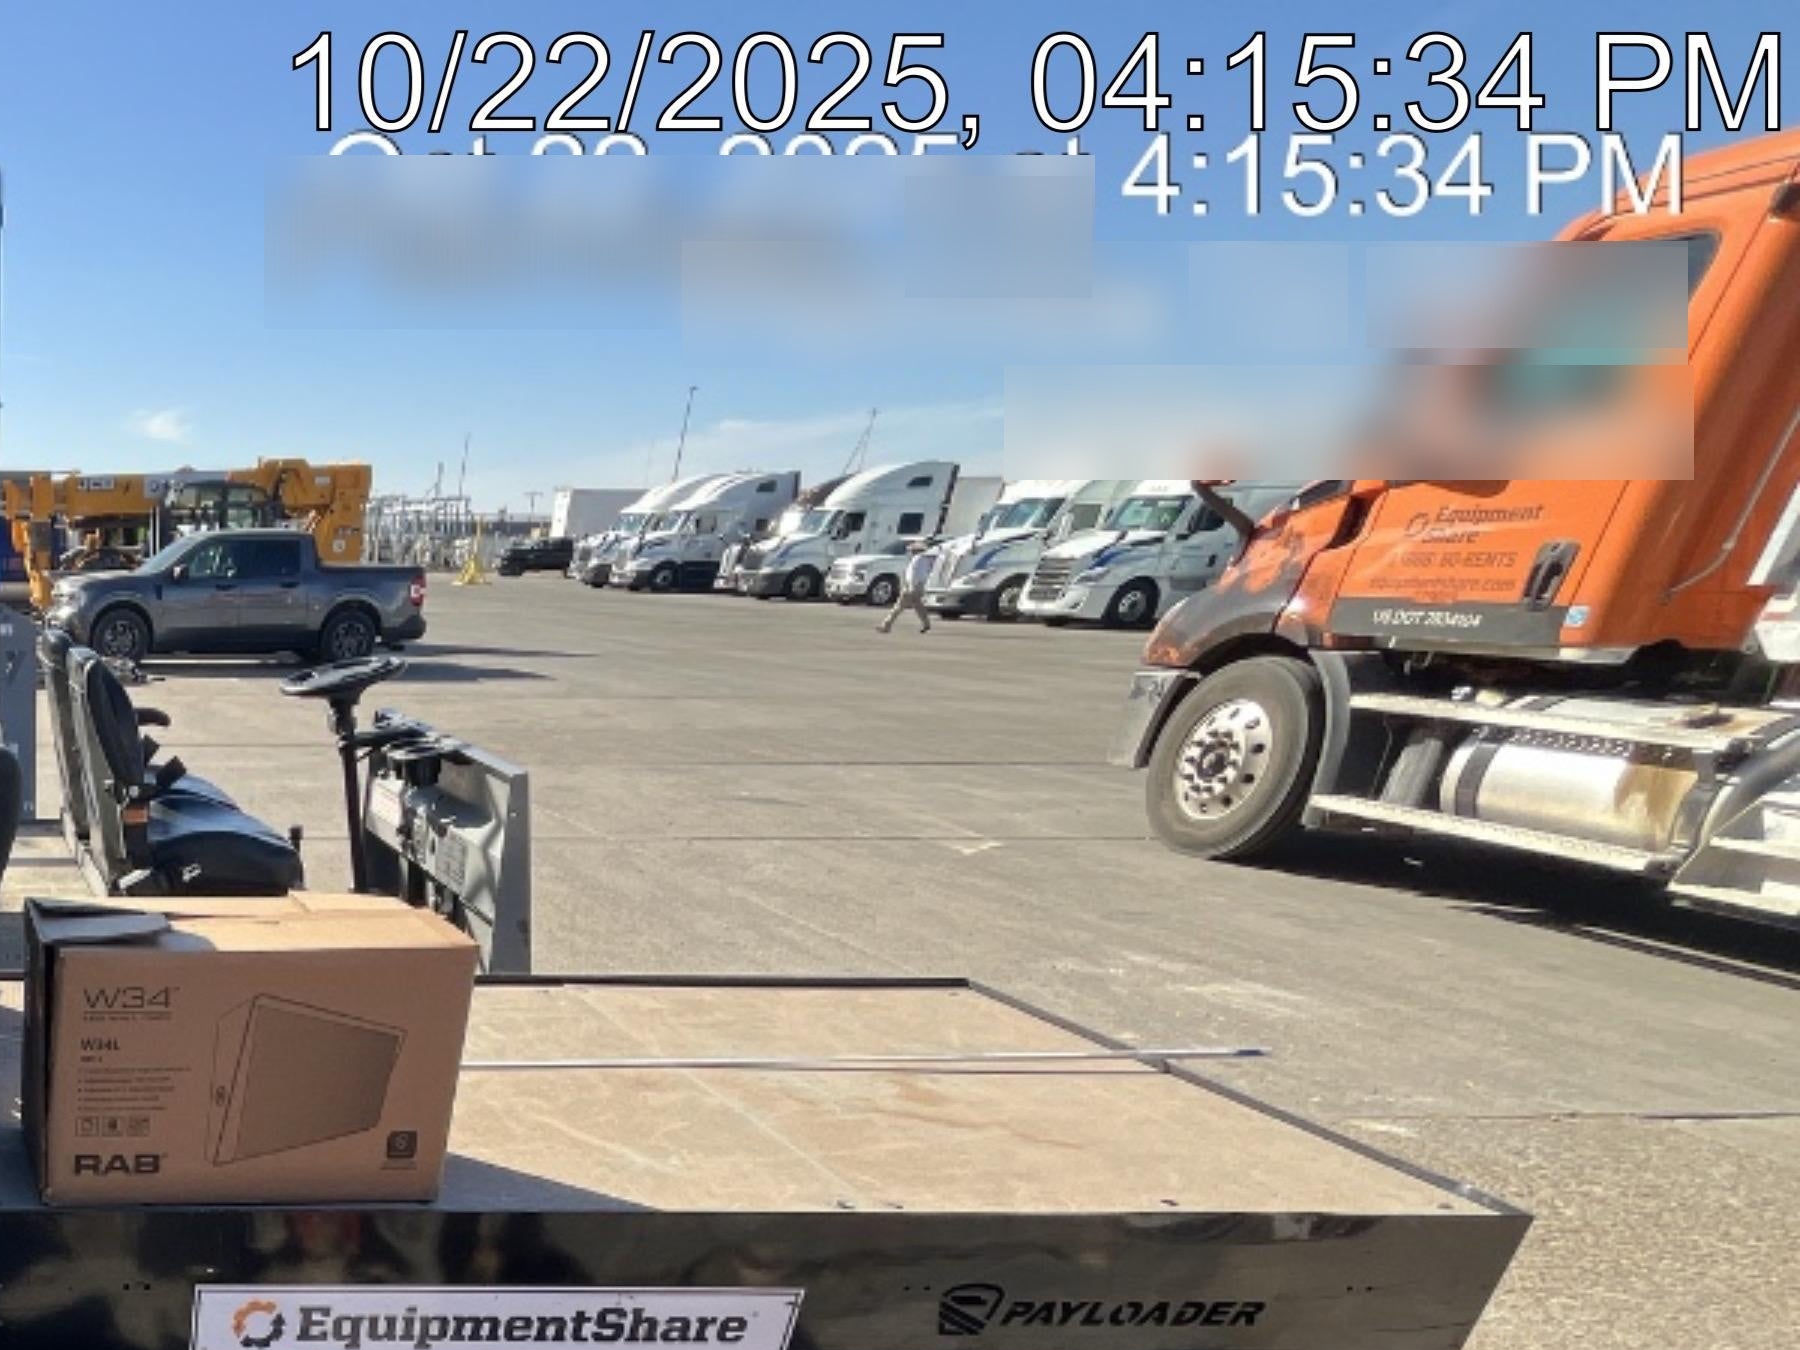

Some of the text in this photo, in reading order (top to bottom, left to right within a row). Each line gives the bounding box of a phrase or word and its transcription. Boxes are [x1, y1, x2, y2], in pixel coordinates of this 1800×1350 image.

[1435, 505, 1543, 524] Equipment
[83, 986, 172, 1009] W34
[74, 1153, 161, 1177] RAB
[1001, 1301, 1267, 1327] PAYLOADER
[297, 1307, 749, 1350] EquipmentShare
